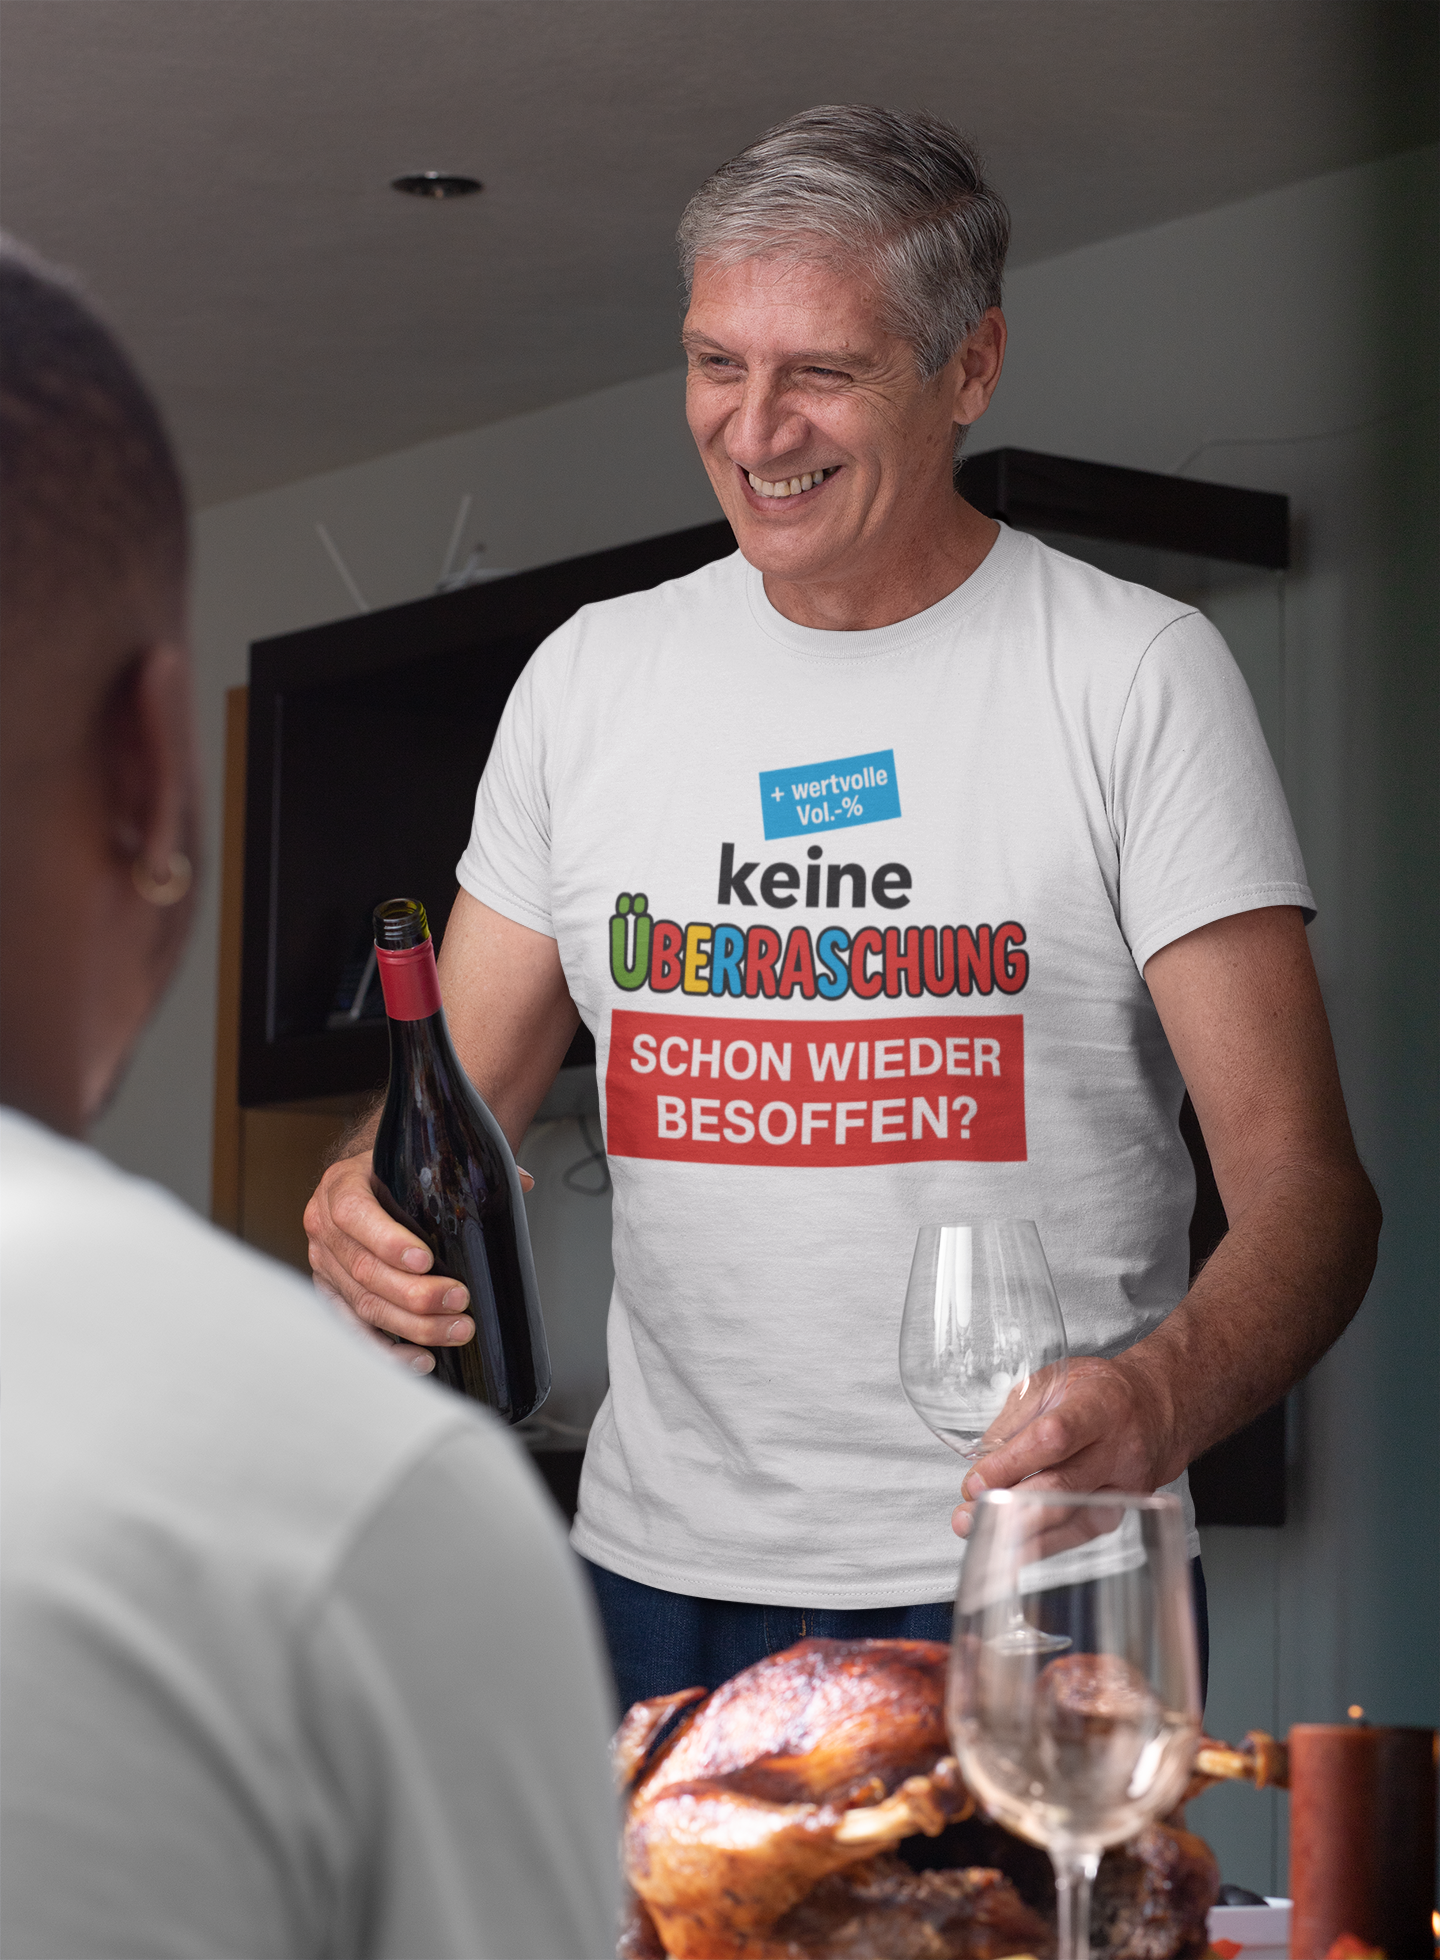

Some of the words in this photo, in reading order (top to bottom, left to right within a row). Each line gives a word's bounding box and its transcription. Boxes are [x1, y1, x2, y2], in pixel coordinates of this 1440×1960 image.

[771, 786, 785, 802] +
[791, 766, 888, 800] wertvolle
[796, 795, 863, 826] Vol.-%
[717, 842, 913, 910] keine
[609, 892, 1029, 1000] ÜBERRASCHUNG
[630, 1034, 792, 1082] SCHON
[807, 1037, 1001, 1082] WIEDER
[656, 1095, 978, 1146] BESOFFEN?
